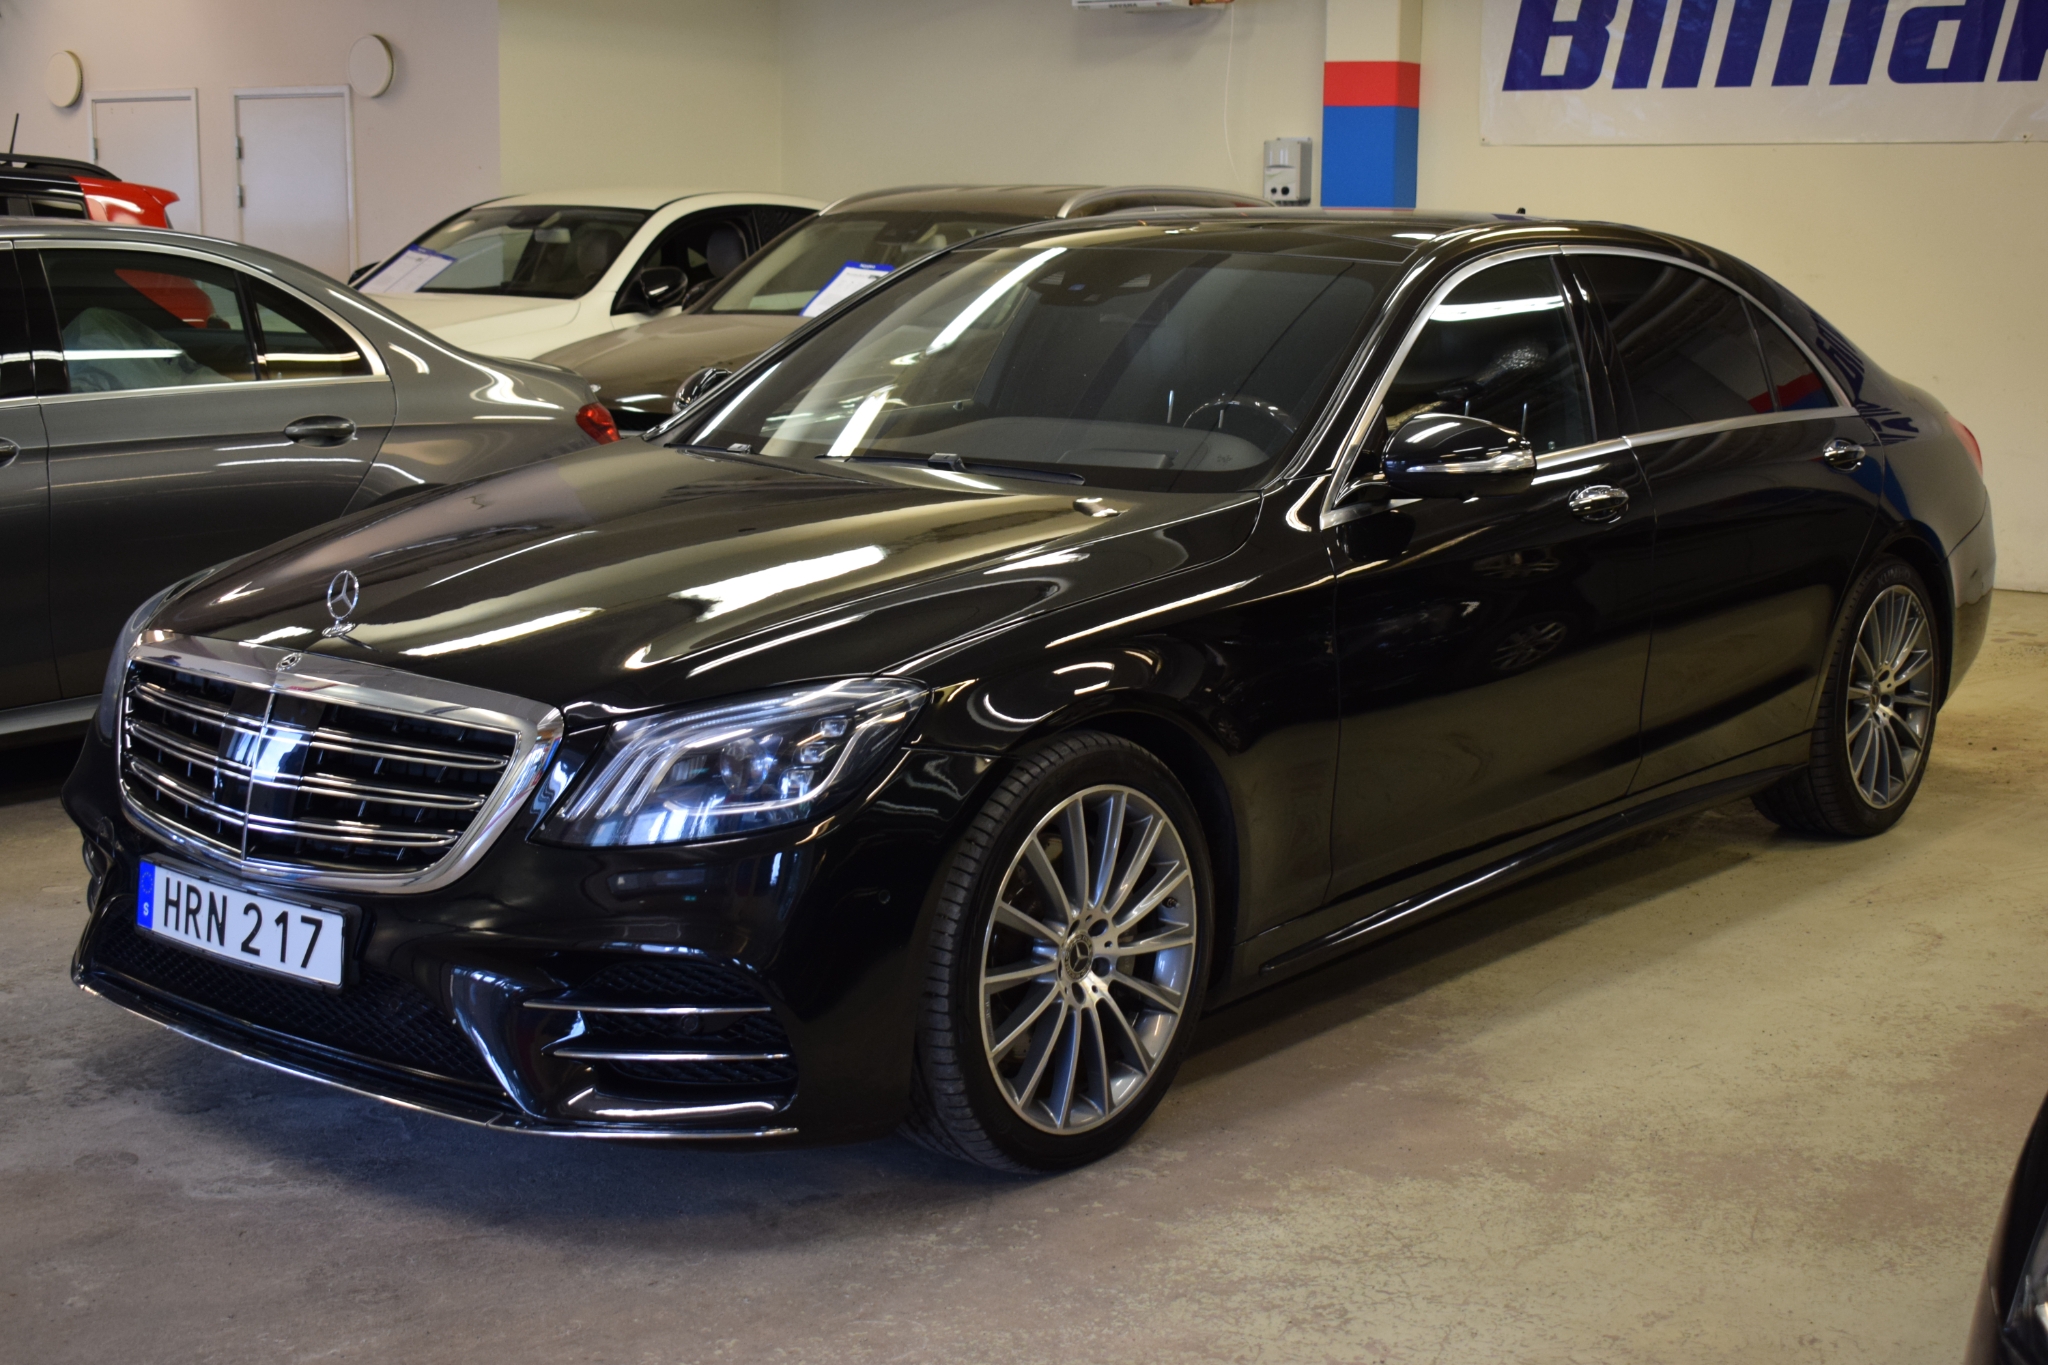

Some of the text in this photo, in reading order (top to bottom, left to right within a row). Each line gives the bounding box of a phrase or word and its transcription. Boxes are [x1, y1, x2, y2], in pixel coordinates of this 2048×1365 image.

[143, 902, 150, 916] S
[163, 876, 323, 969] HRN 217
